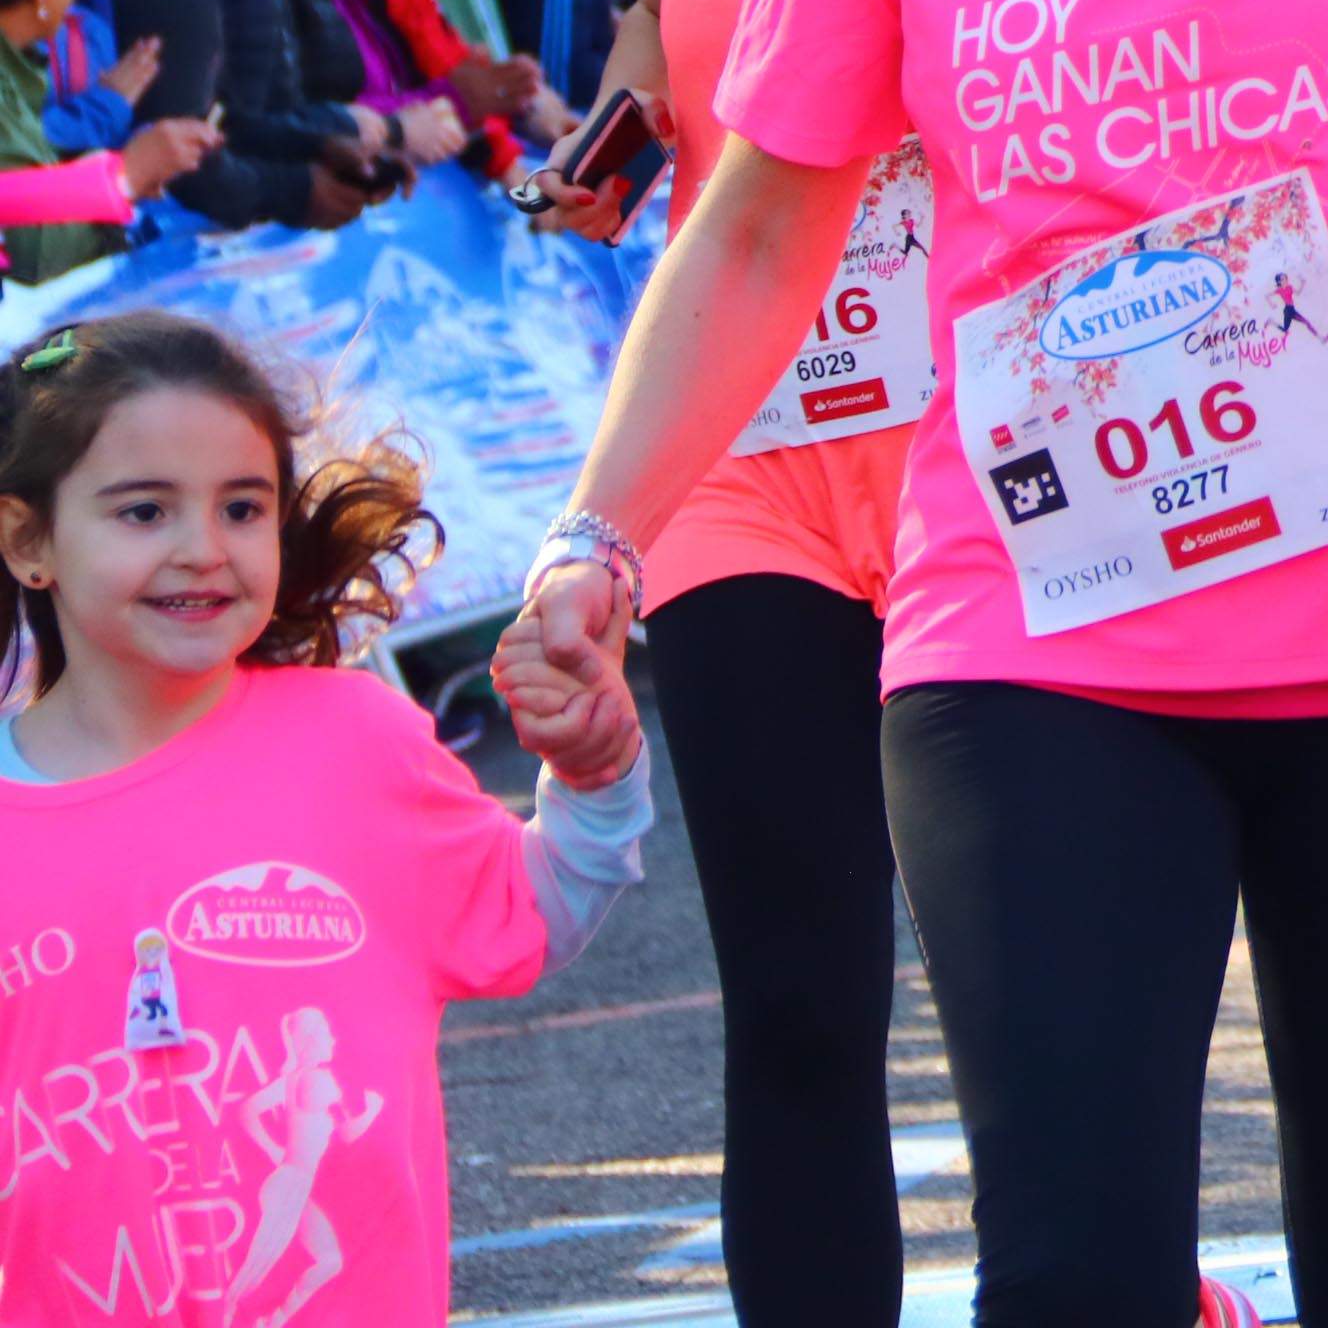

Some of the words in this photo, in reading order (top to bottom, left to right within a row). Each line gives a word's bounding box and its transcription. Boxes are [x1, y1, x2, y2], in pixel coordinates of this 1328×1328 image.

[955, 20, 1200, 132] GANAN
[970, 123, 1076, 204] LAS
[842, 241, 886, 263] arrera
[867, 253, 908, 280] Mujer
[815, 287, 878, 342] 16
[1057, 276, 1218, 351] ASTURIANA
[1185, 319, 1259, 355] Carrera
[1210, 354, 1222, 367] de
[1225, 345, 1235, 361] la
[1238, 330, 1290, 371] Mujer
[797, 351, 857, 382] 6029
[826, 391, 876, 411] Santander
[1094, 380, 1257, 480] 016
[1152, 464, 1229, 515] 8277
[1197, 515, 1264, 547] Santander
[1044, 556, 1133, 601] OYSHO
[184, 901, 356, 943] ASTURIANA
[0, 1024, 270, 1202] ARRERA
